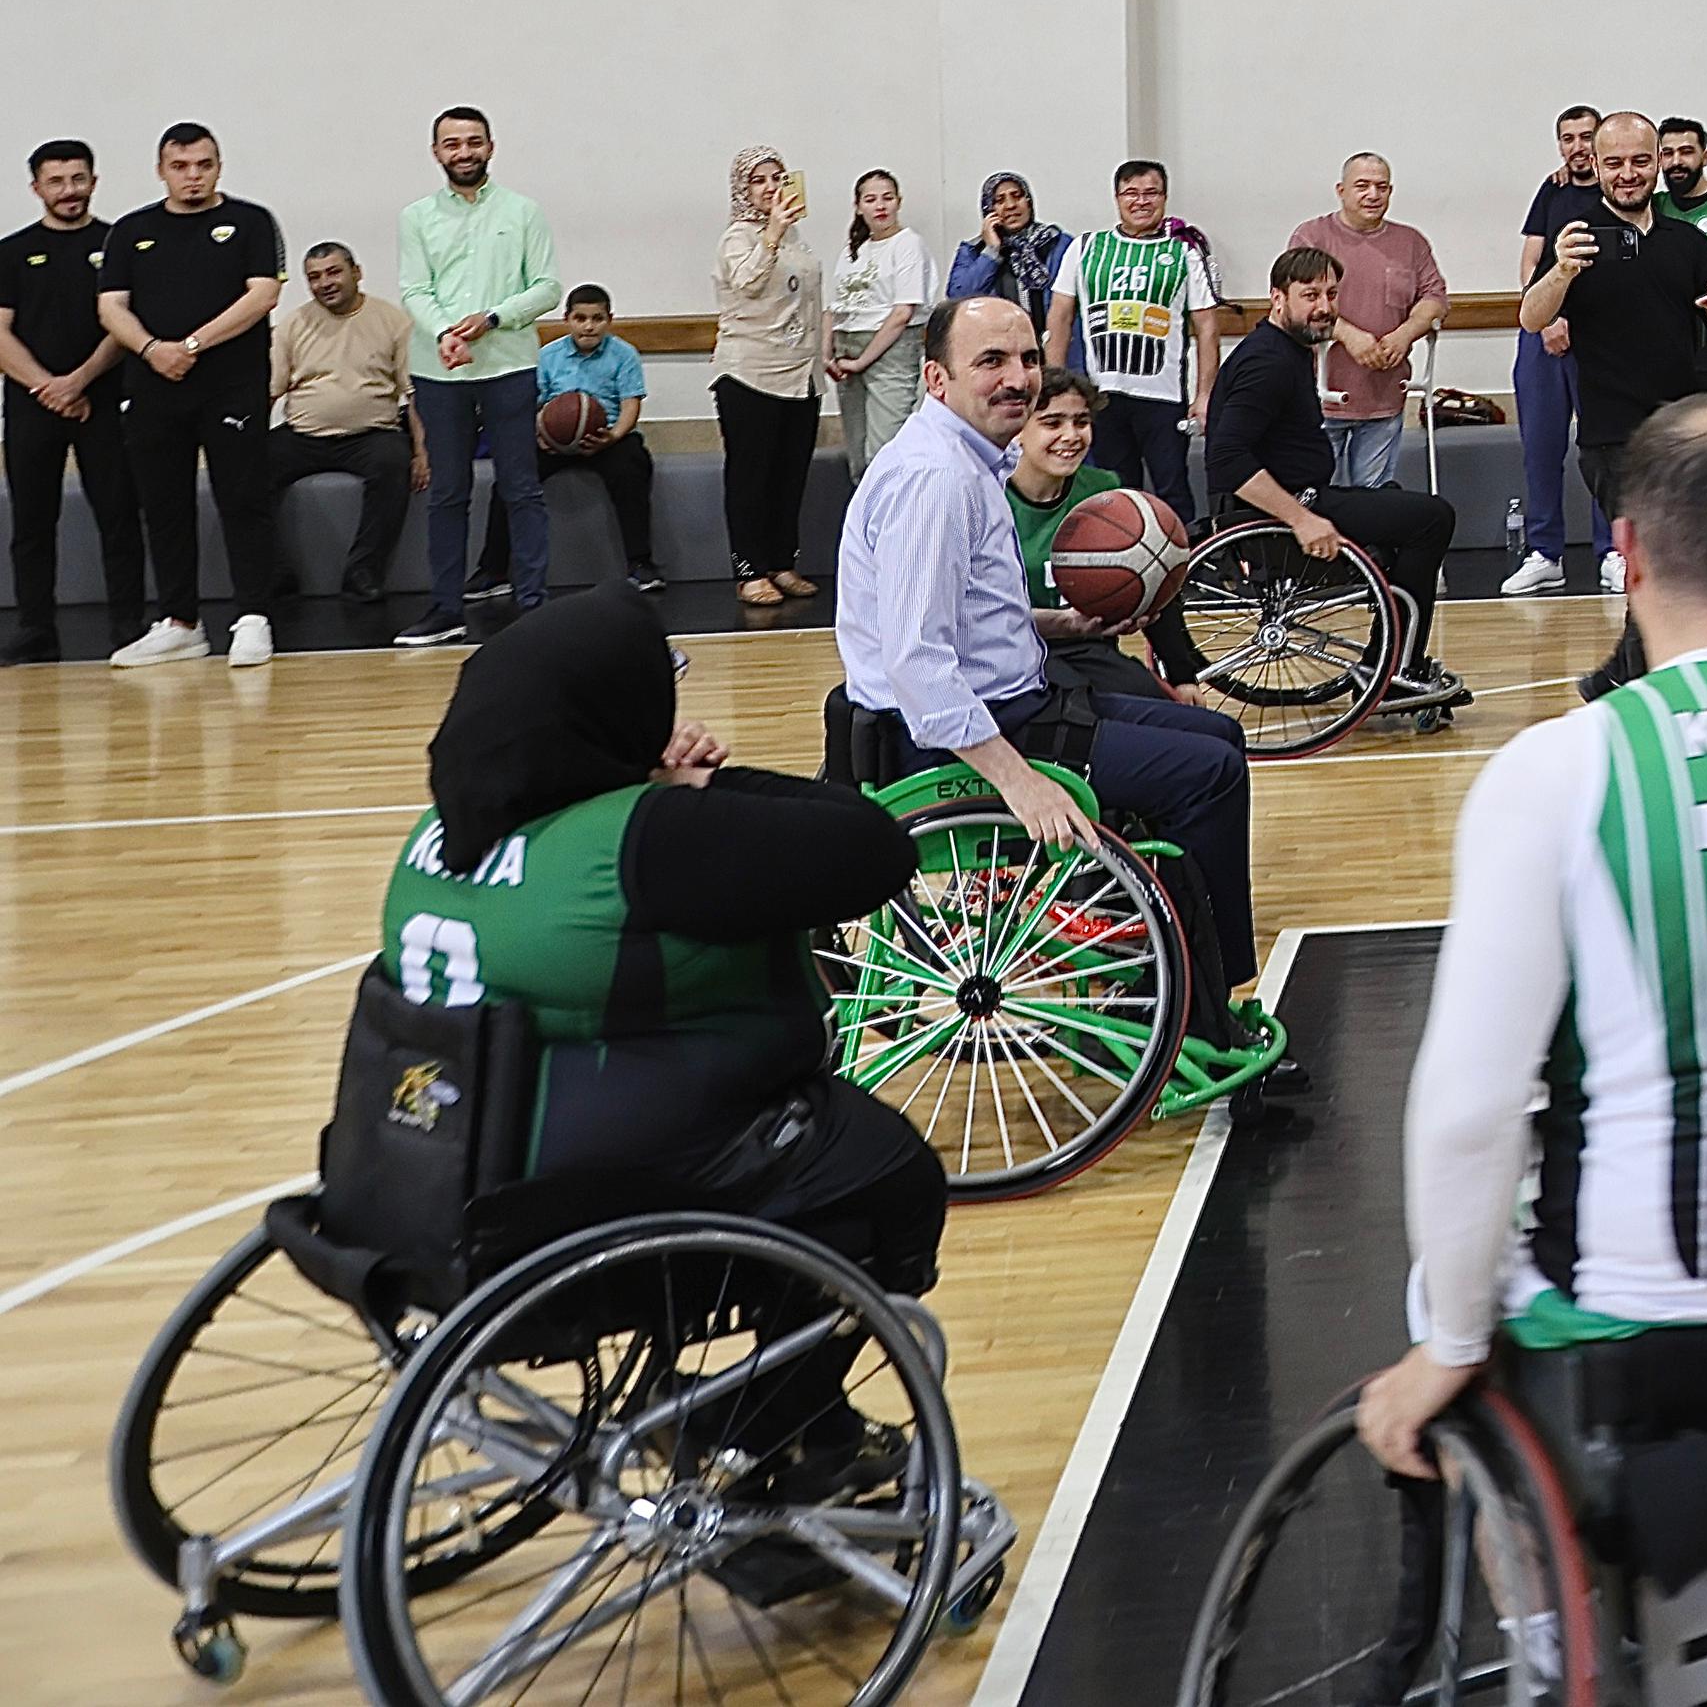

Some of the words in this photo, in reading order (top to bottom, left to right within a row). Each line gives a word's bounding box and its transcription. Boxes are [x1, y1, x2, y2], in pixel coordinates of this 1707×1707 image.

[1111, 265, 1150, 293] 26
[936, 777, 1002, 799] EXT
[406, 818, 528, 887] KYA
